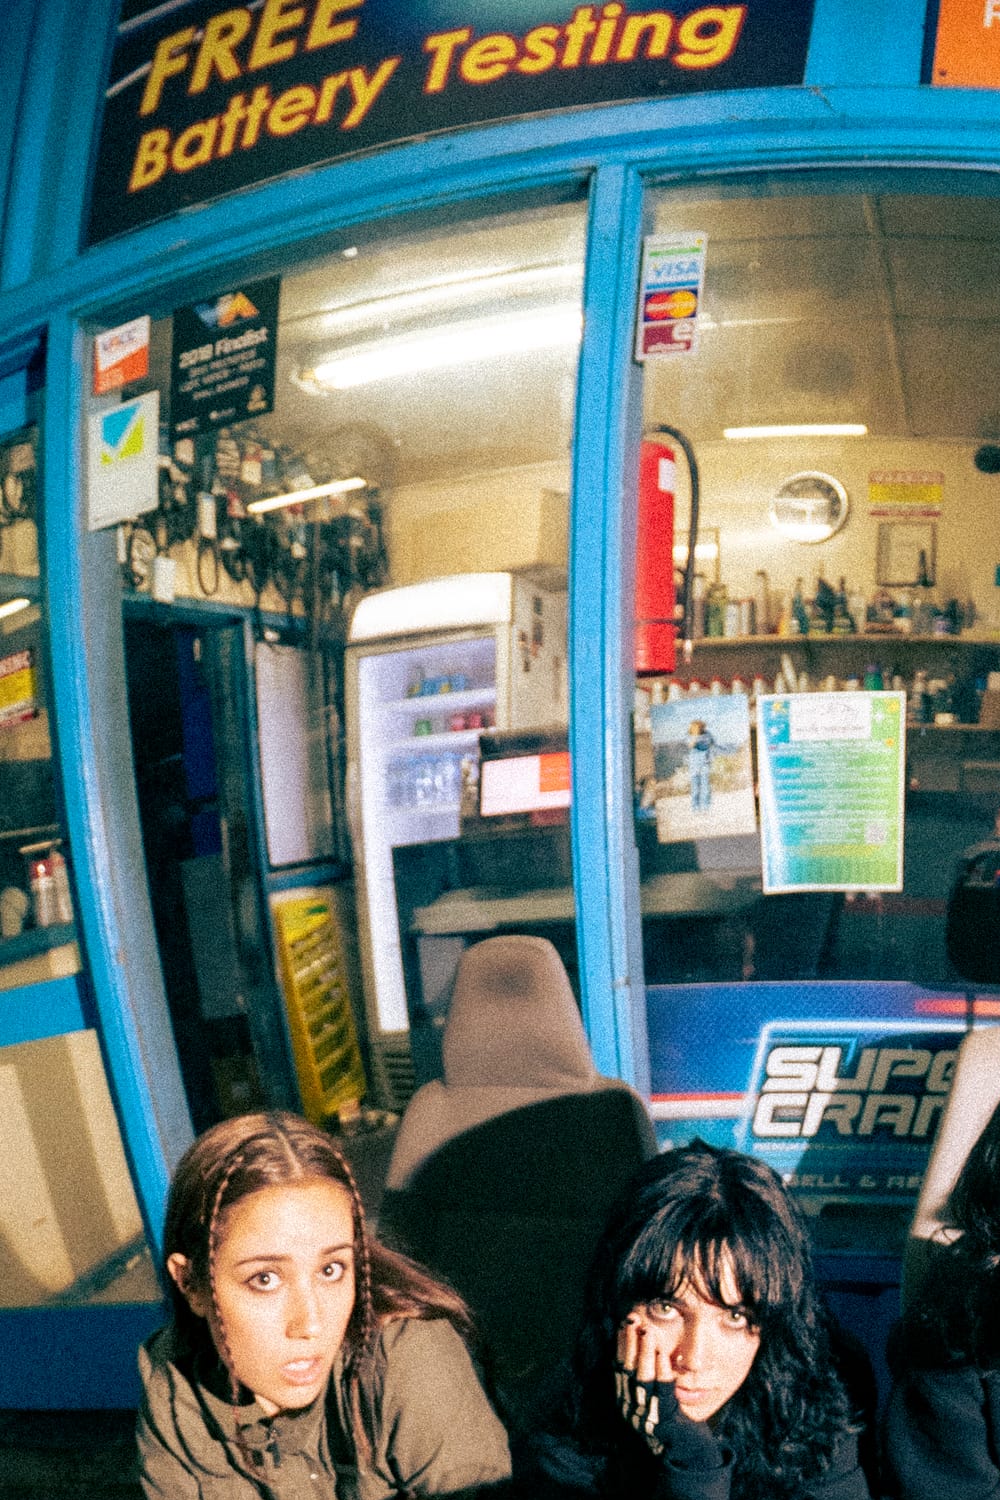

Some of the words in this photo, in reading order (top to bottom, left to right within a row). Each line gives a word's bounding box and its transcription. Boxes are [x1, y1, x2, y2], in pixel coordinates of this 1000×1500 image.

[139, 0, 365, 117] FREE
[127, 55, 402, 193] Battery
[423, 1, 747, 94] Testing
[653, 261, 699, 276] VISA
[762, 1046, 962, 1093] SUPE
[752, 1093, 951, 1138] CRAN
